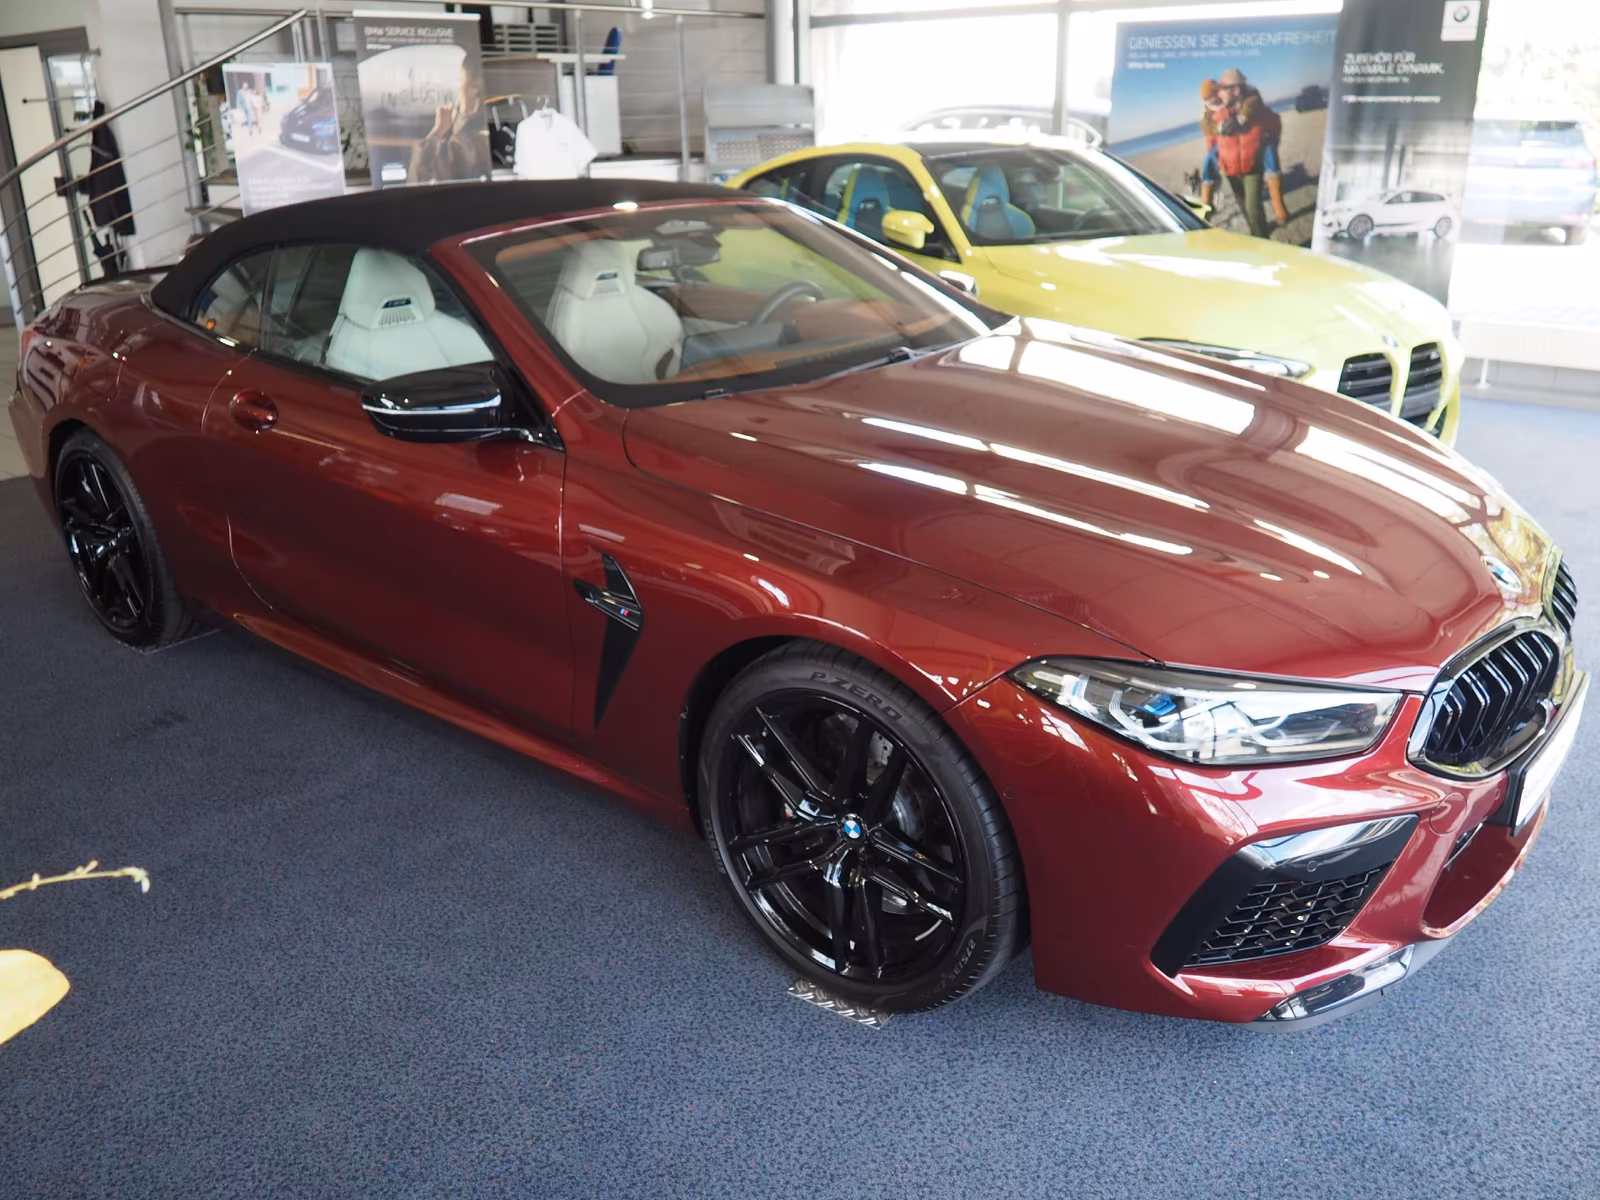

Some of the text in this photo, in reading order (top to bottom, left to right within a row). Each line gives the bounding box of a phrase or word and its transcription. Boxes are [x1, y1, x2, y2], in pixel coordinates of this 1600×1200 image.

[384, 26, 416, 37] SERVICE
[417, 27, 455, 38] INCLUSIVE
[1128, 29, 1337, 50] GENIESSEN SIE SORGENFREIHEIT
[1343, 50, 1416, 64] ZUBEHÖR FÜR
[830, 676, 904, 720] ZERO
[948, 939, 977, 981] 275/35
